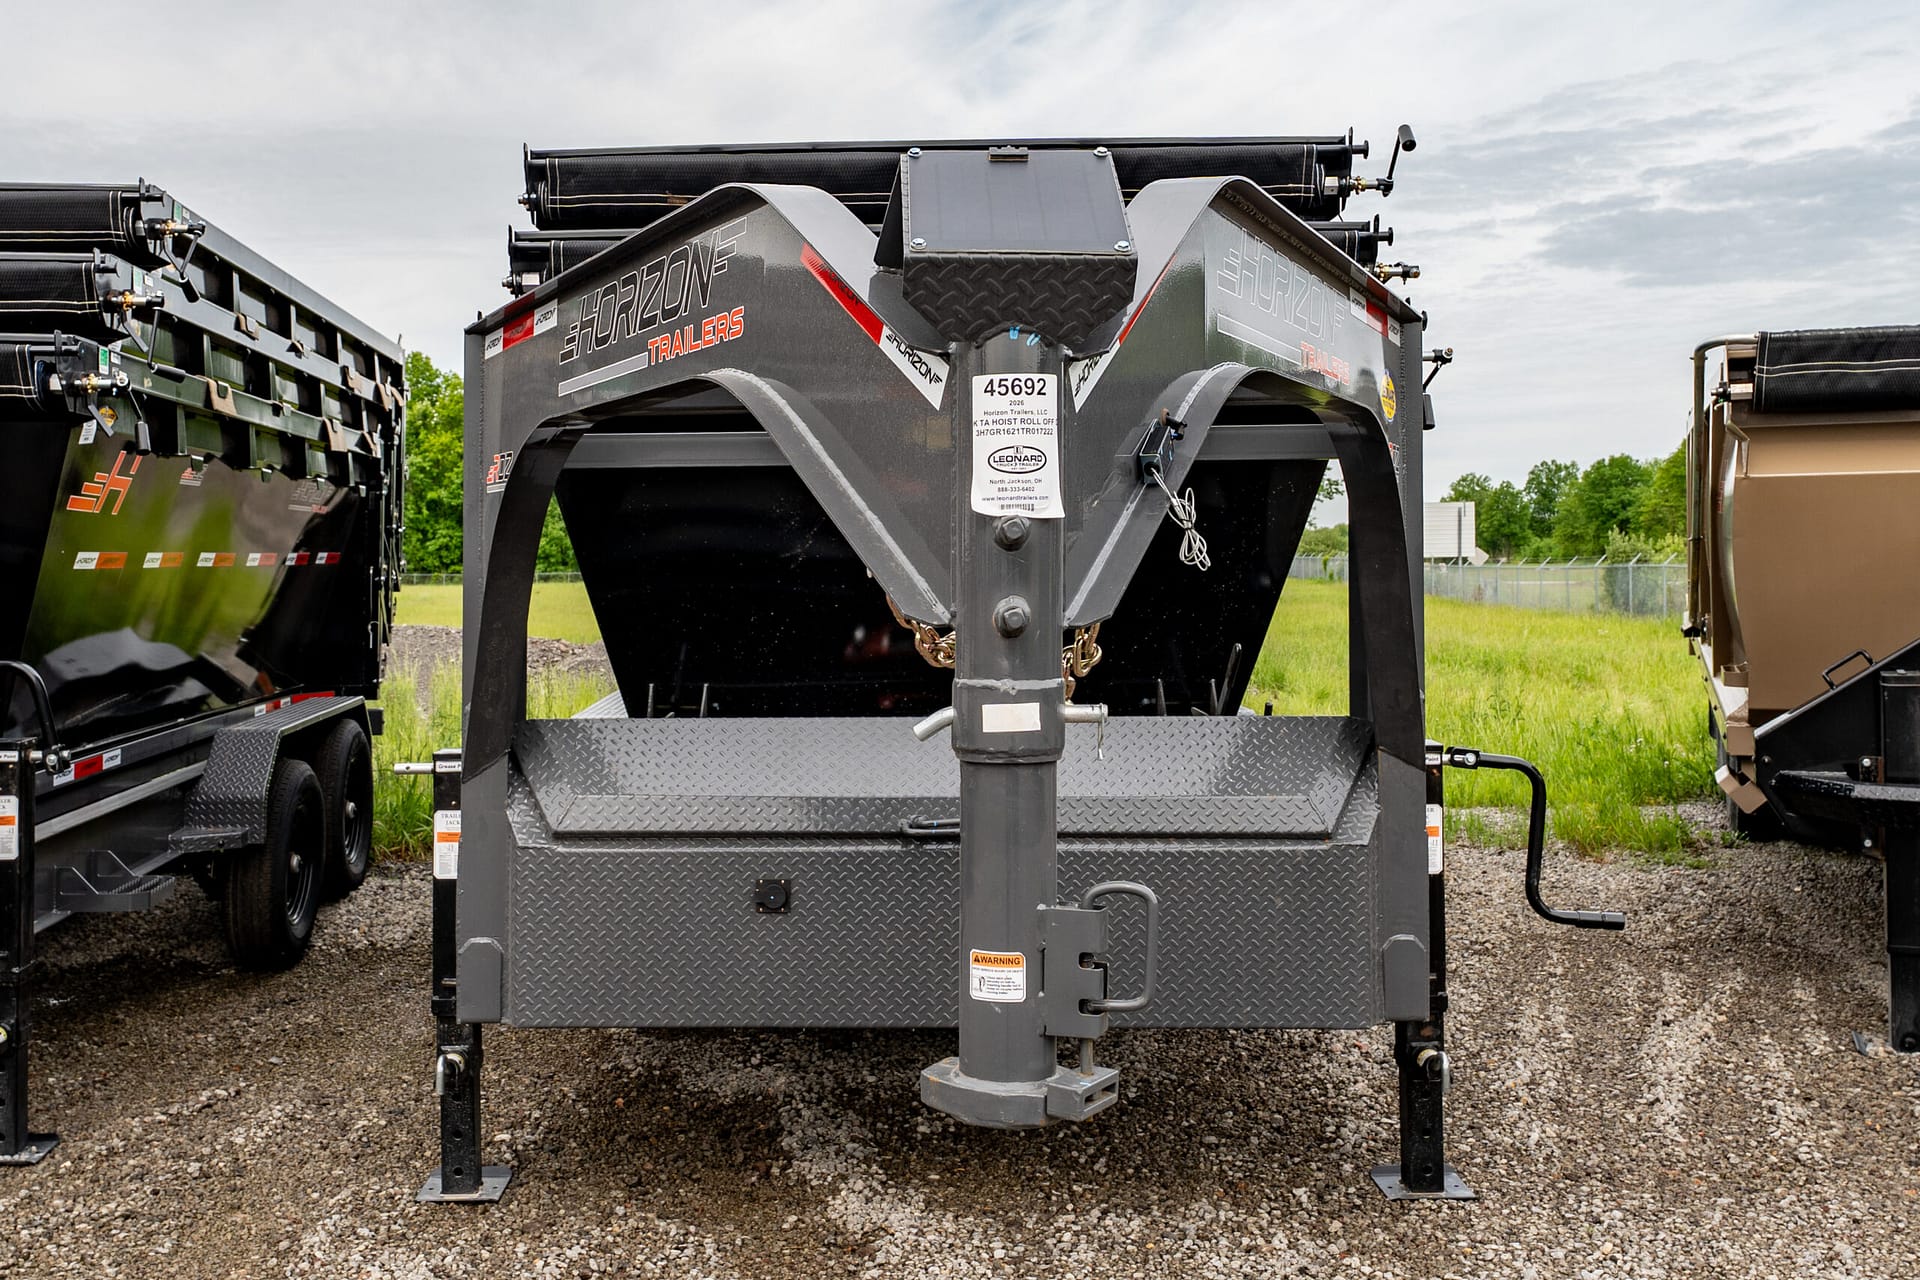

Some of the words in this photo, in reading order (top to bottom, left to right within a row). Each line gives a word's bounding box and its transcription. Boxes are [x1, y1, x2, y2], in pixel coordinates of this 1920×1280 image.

[559, 217, 747, 365] HORIZON
[1217, 228, 1347, 346] HORIZON
[647, 306, 745, 365] TRAILERS
[885, 332, 943, 385] HORIZON
[983, 377, 1047, 397] 45692
[980, 419, 990, 427] TA
[991, 417, 1018, 426] HOIST
[1019, 417, 1041, 426] ROLL
[1042, 417, 1055, 426] OFF
[983, 409, 1009, 417] Horizon
[1037, 408, 1048, 416] LLC
[992, 454, 1043, 463] LEONARD
[980, 956, 1021, 966] WARNING
